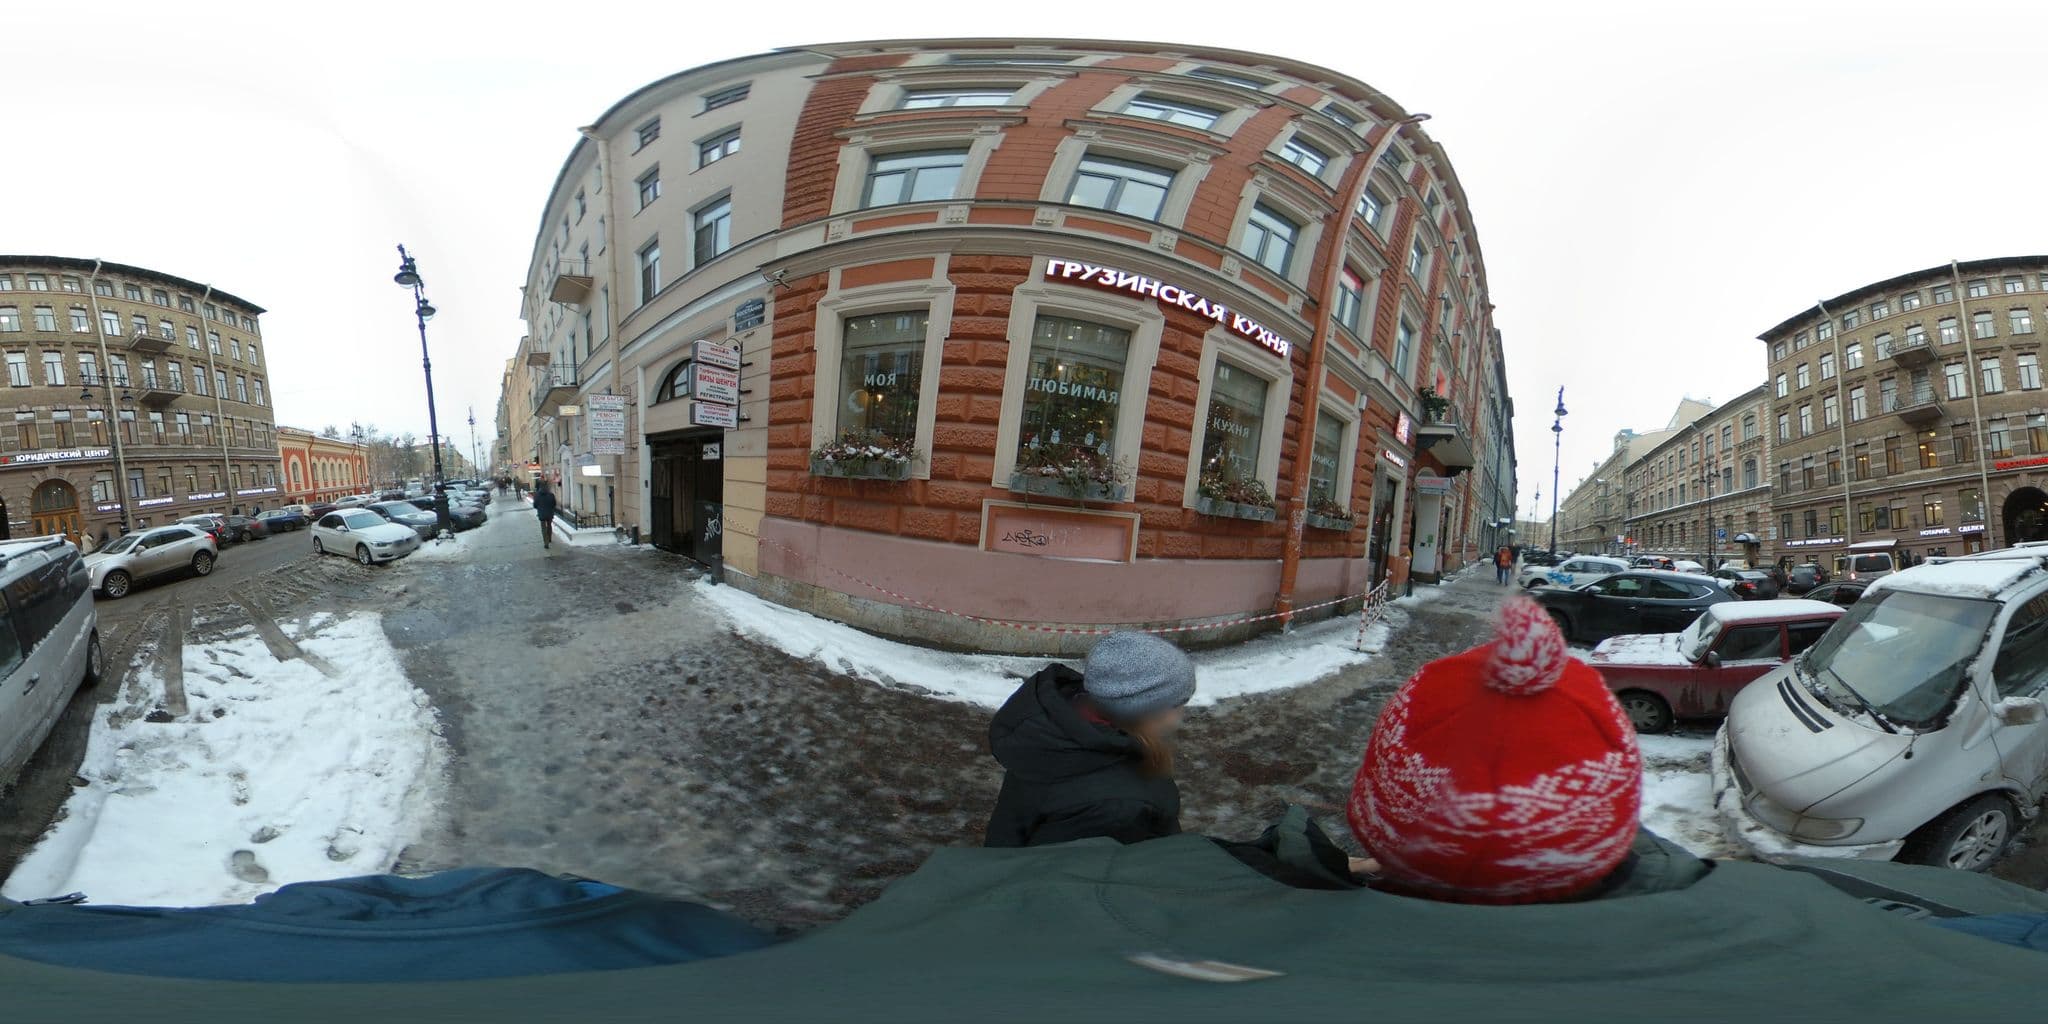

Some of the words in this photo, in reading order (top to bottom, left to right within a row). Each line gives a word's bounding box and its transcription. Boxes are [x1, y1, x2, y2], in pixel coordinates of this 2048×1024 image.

[1046, 259, 1225, 322] ГРУЗИНСКАЯ
[1232, 313, 1290, 356] КУХНЯ
[864, 373, 896, 386] МОЯ
[1027, 378, 1118, 404] ЛЮБИМАЯ
[1213, 417, 1249, 438] КУХНЯ
[15, 450, 81, 462] ЮРИДИЧЕСКИЙ
